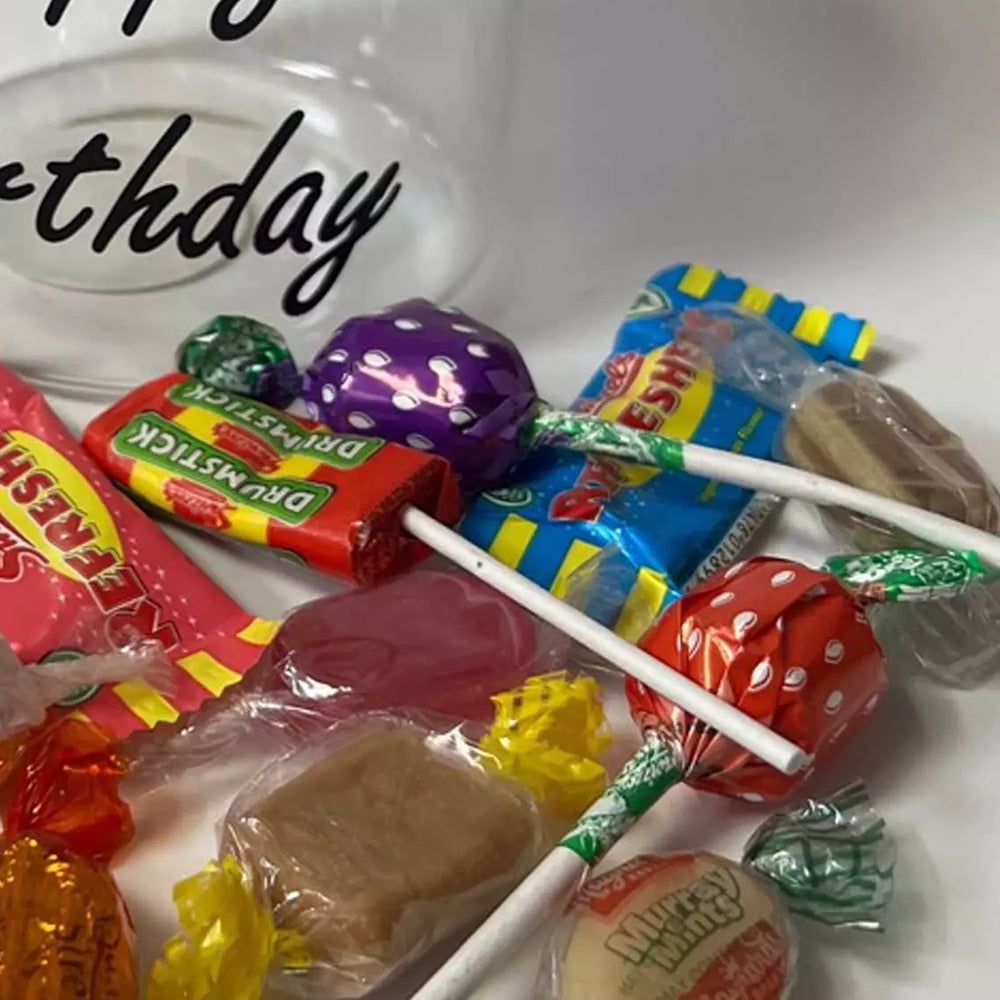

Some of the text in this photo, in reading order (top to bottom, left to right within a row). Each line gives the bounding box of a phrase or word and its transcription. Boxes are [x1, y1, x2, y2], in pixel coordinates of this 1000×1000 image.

[127, 421, 316, 514] DRUMSTICK
[604, 867, 741, 966] Murray
[649, 895, 744, 974] Mints
